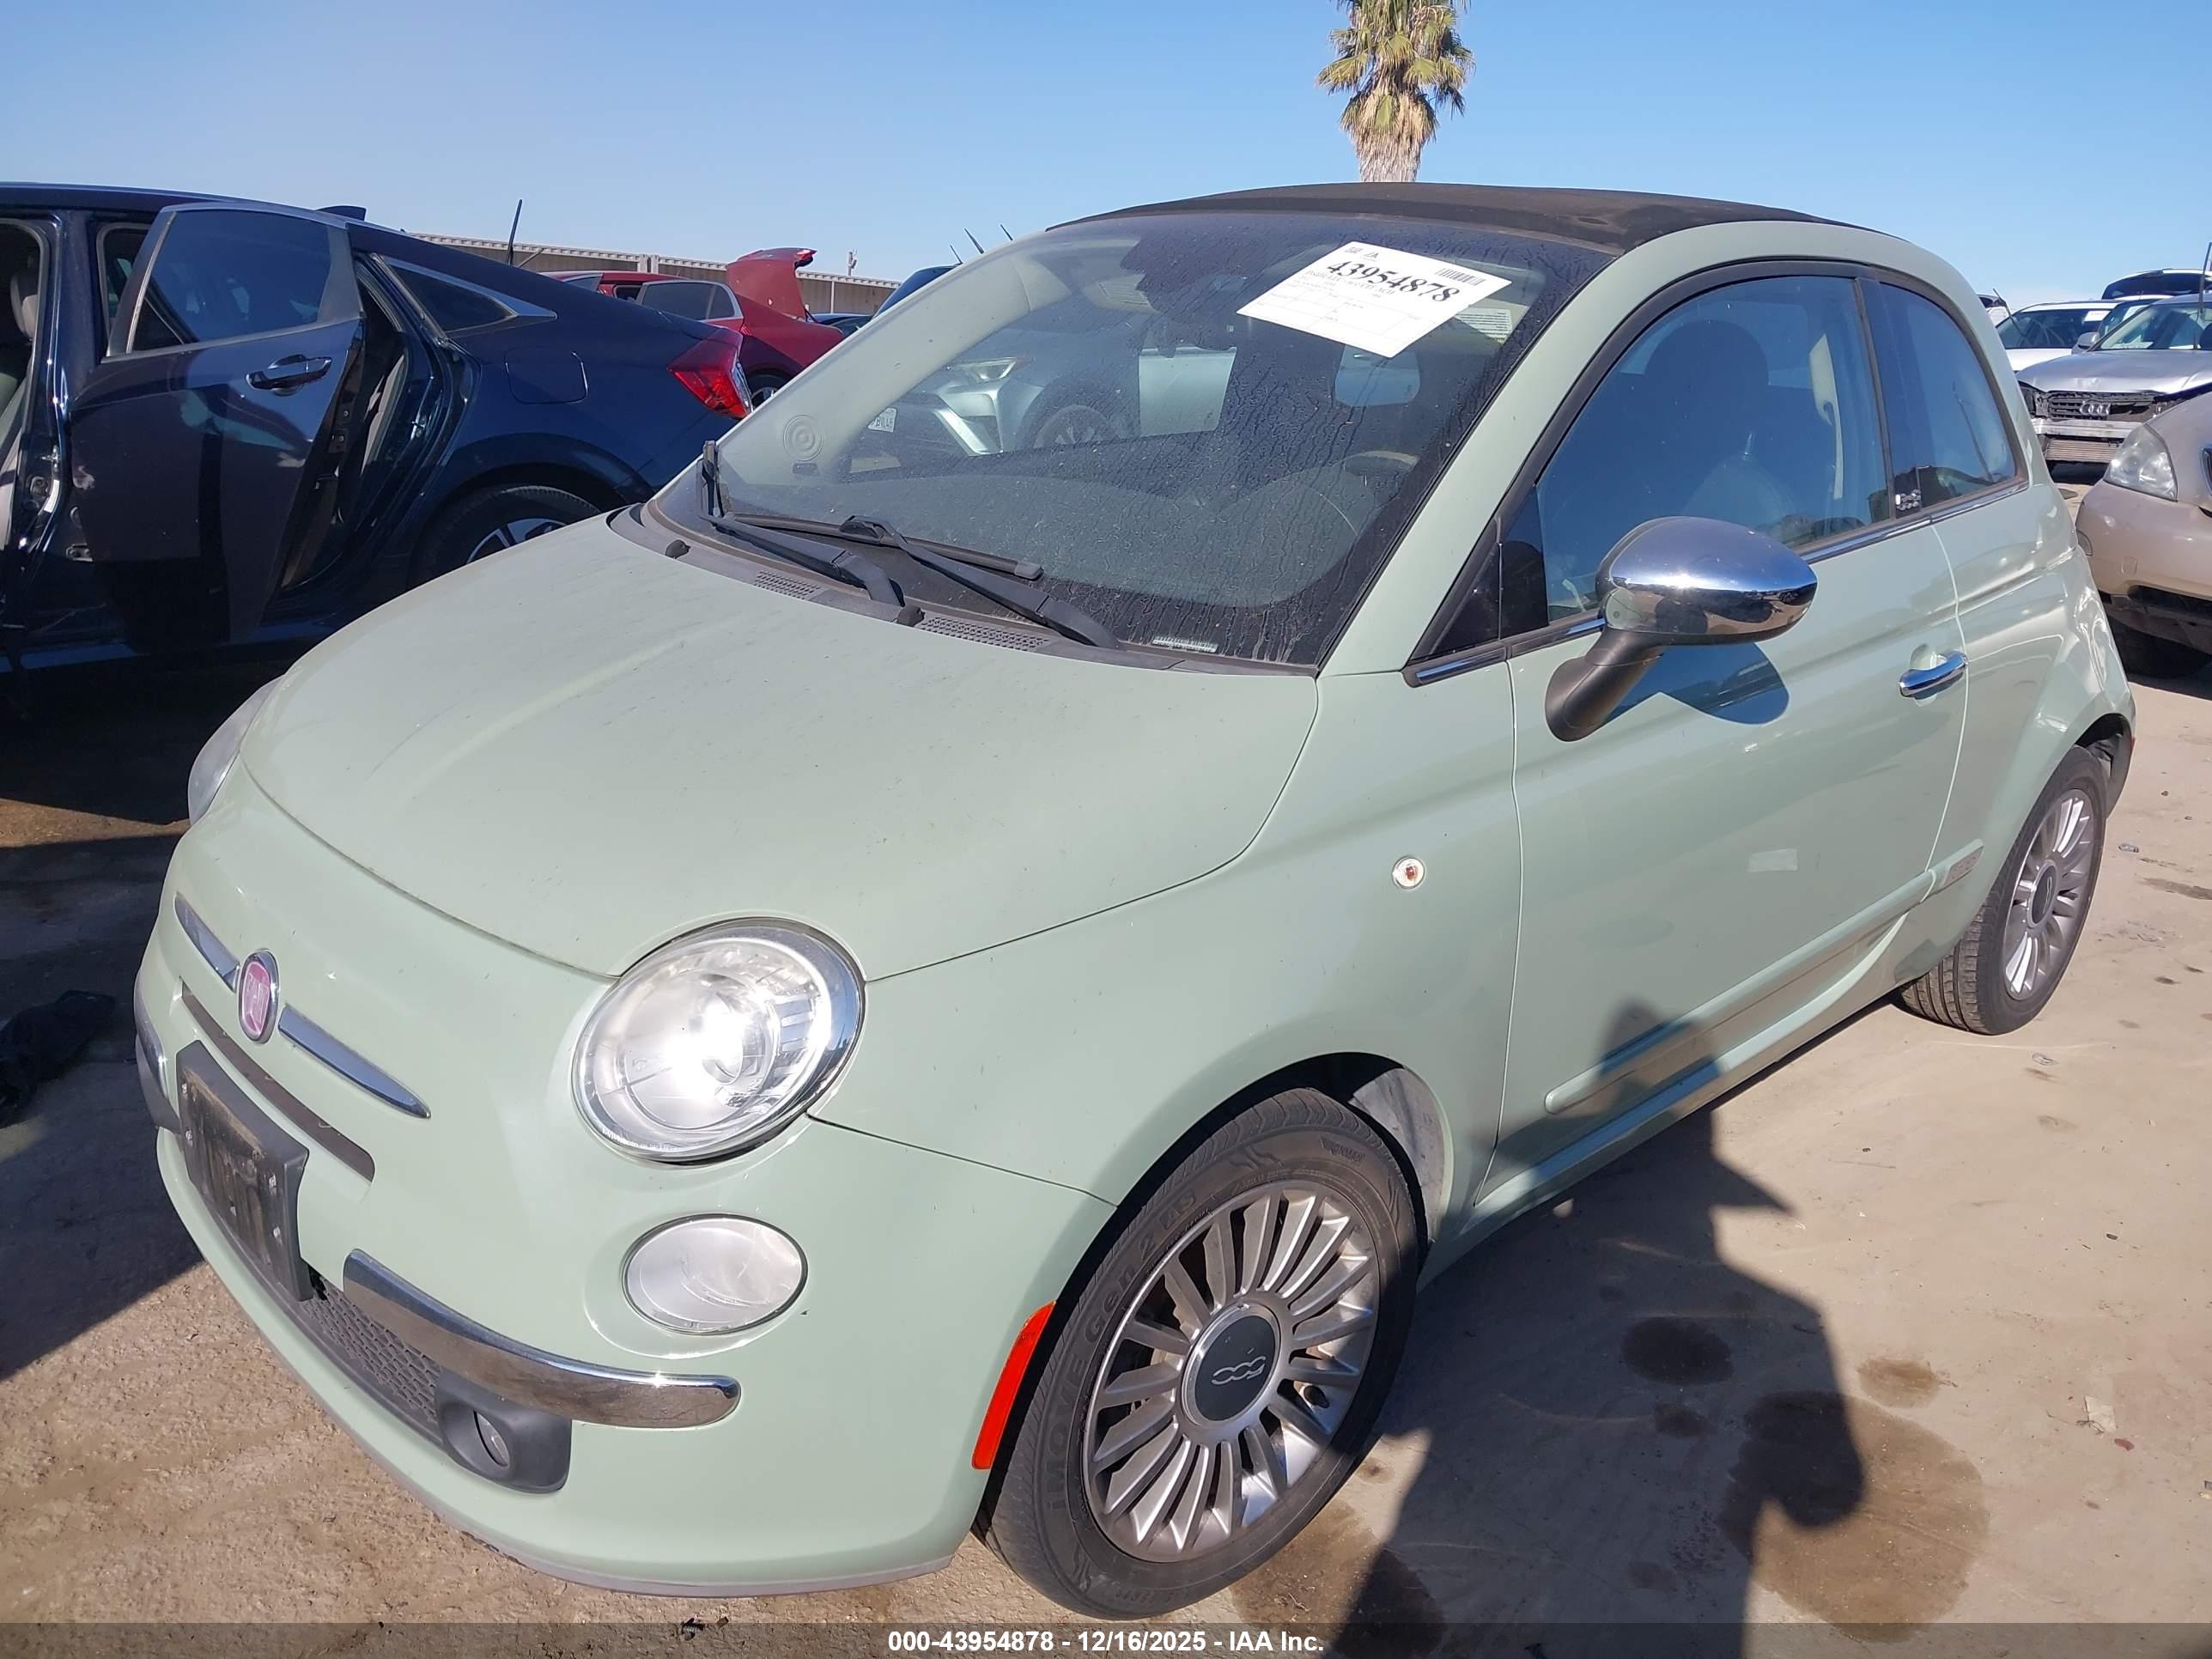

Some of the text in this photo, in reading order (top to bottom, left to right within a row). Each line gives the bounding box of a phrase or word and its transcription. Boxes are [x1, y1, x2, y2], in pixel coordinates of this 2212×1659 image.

[1327, 260, 1460, 302] 43954878
[1084, 1267, 1137, 1342] Gen
[1137, 1231, 1158, 1261] 2
